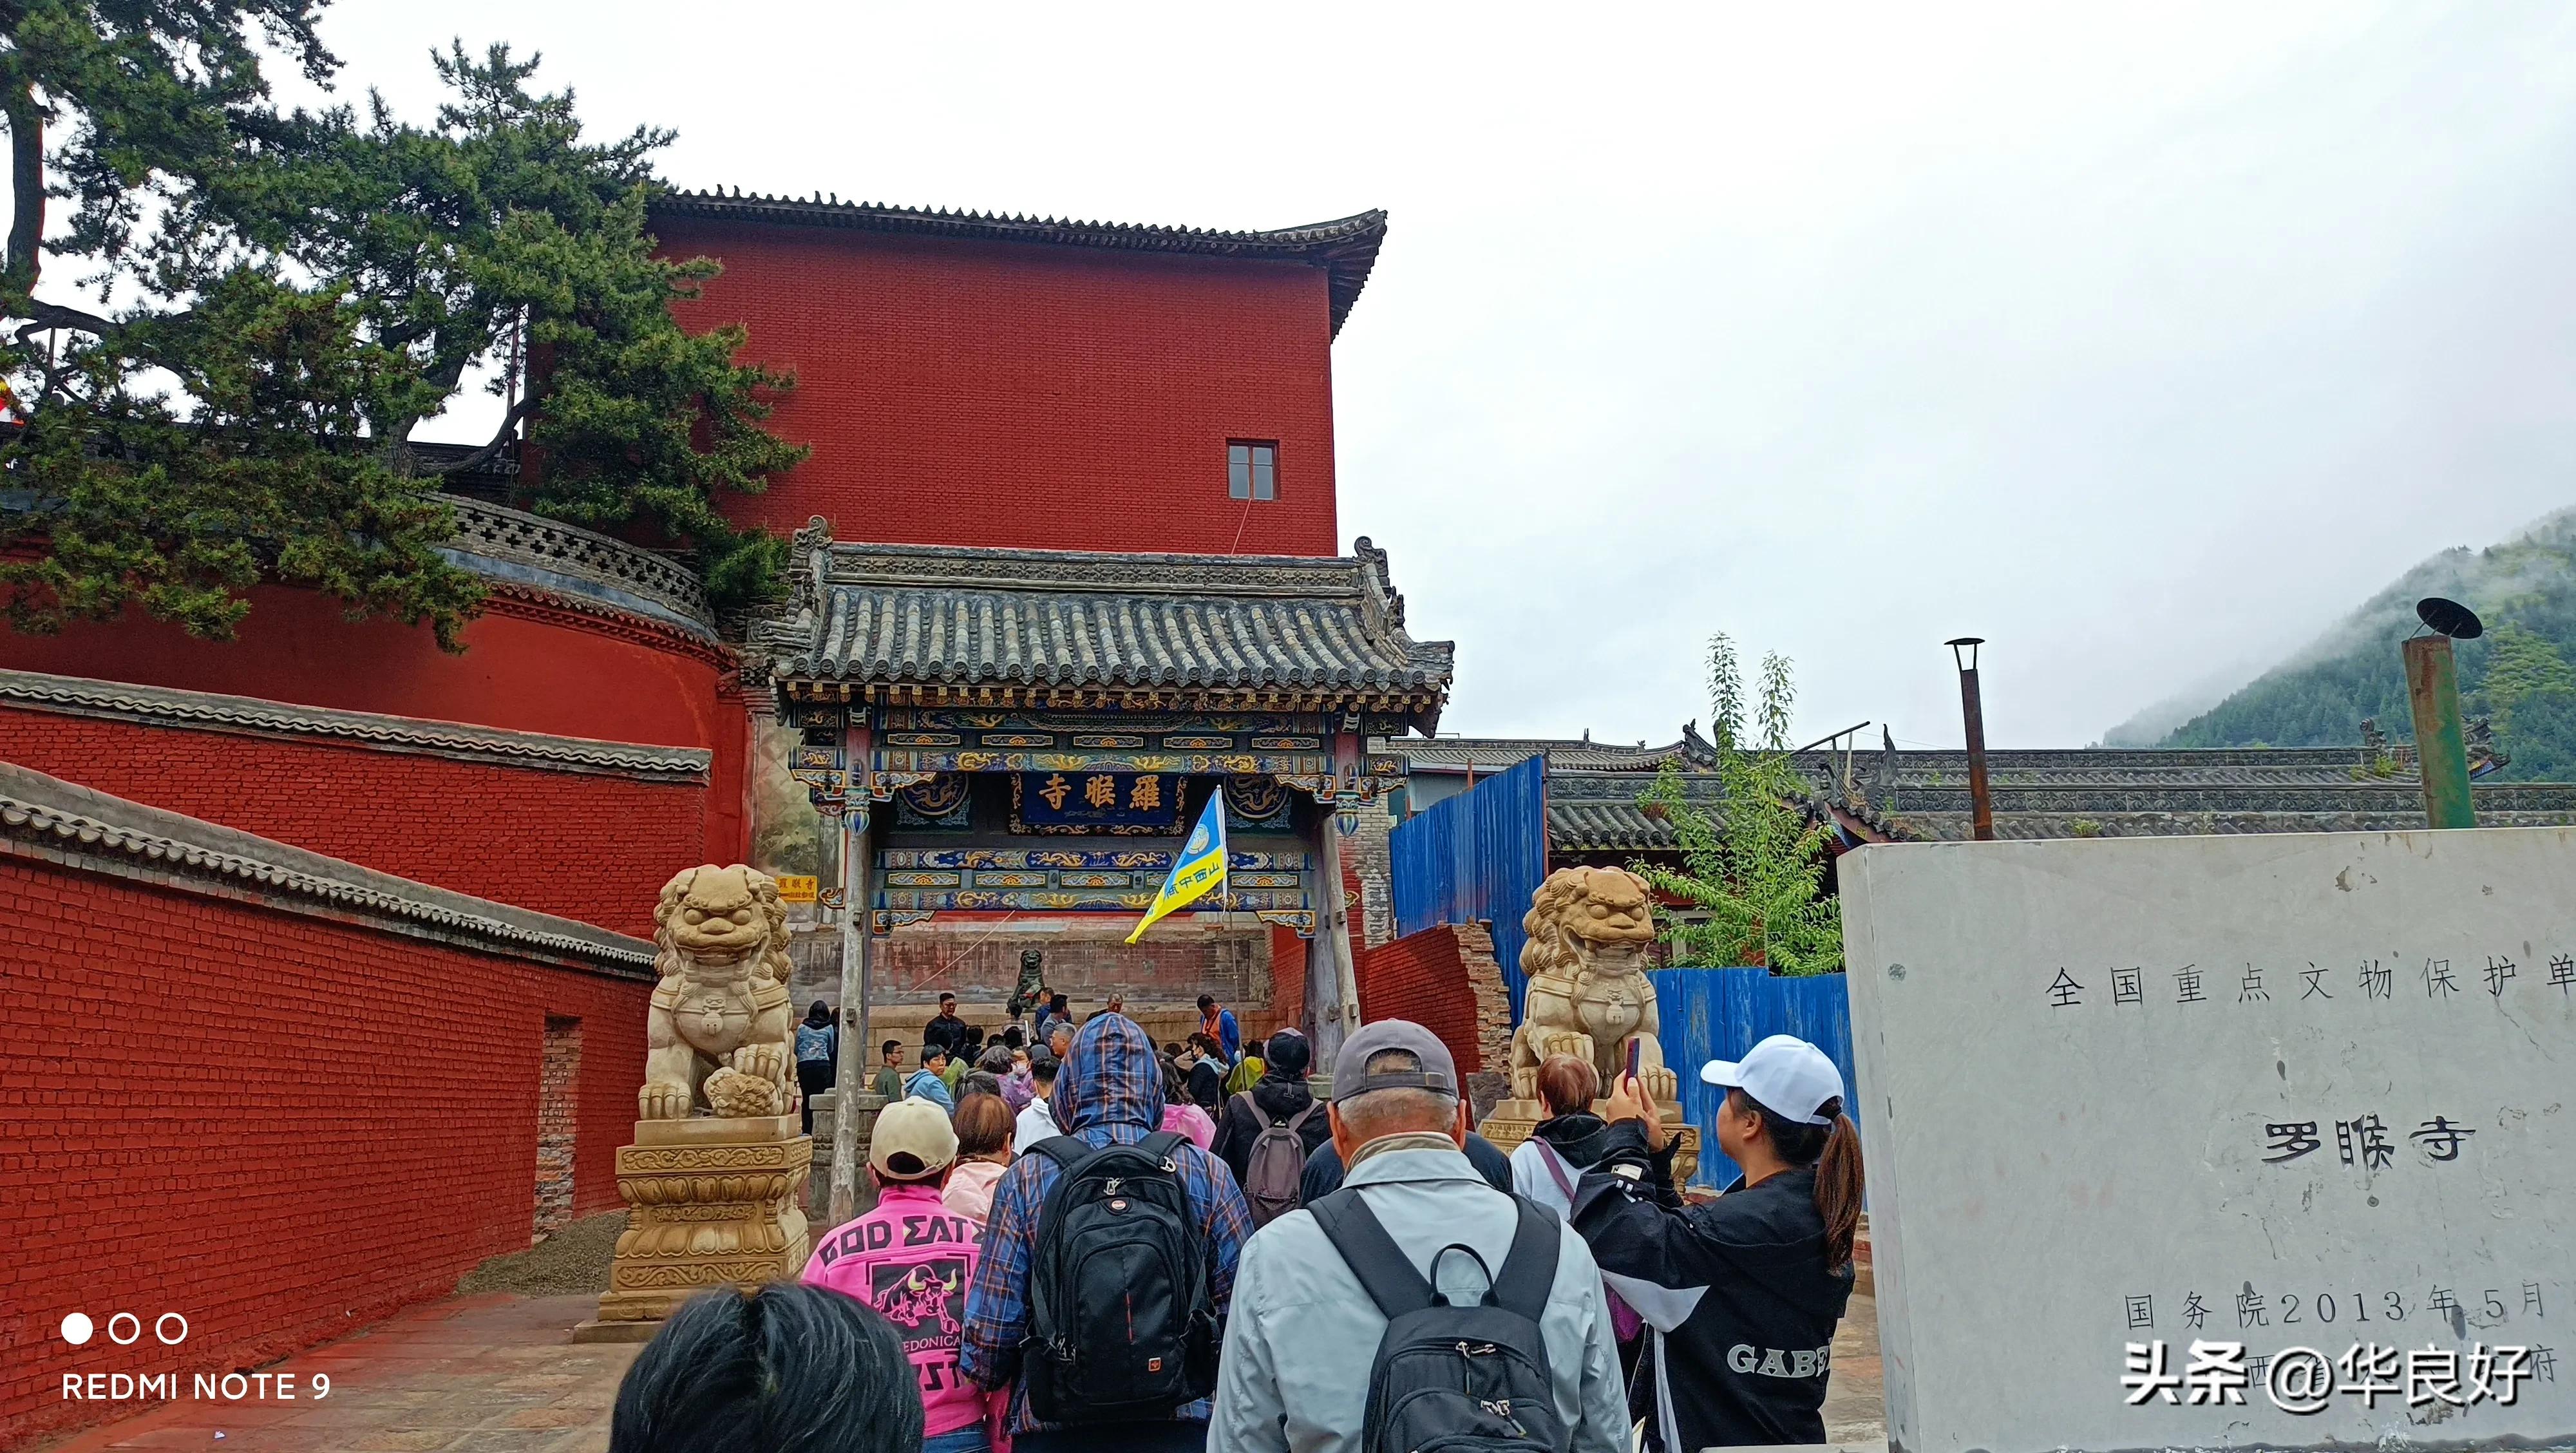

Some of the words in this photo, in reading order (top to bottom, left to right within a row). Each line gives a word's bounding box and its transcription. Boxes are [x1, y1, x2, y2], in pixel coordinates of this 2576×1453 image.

[2045, 953, 2576, 1008] 全国重点文物保护单
[902, 1336, 961, 1353] EDONICA
[1727, 1344, 1831, 1378] GABE
